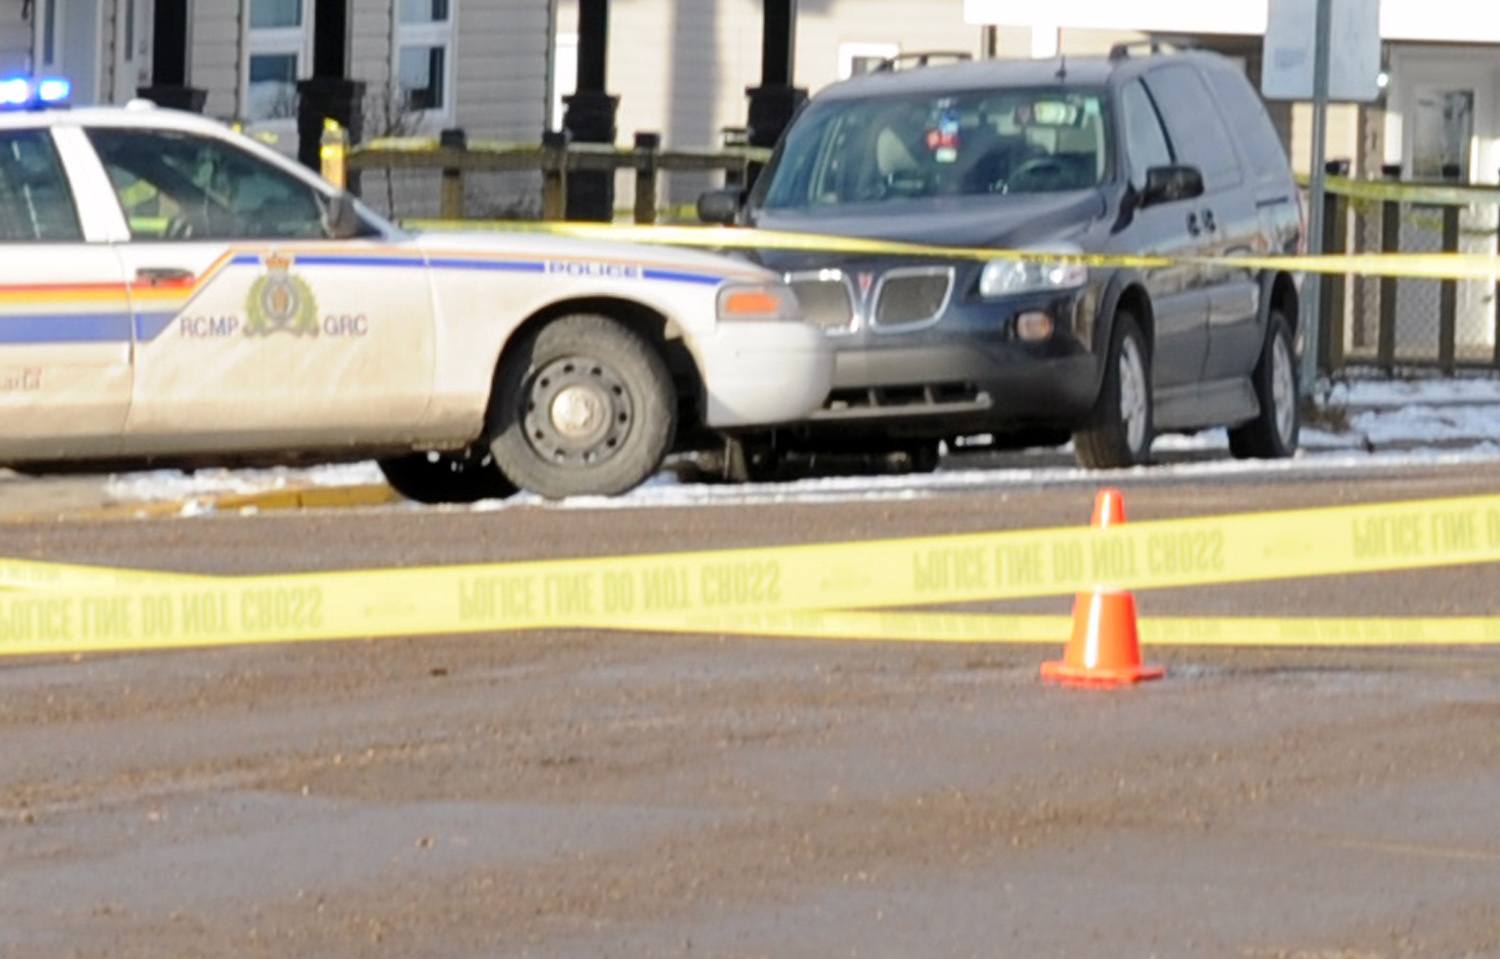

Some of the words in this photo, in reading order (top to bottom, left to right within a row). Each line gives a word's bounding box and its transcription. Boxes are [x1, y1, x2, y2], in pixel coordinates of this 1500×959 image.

[548, 263, 639, 278] POLICE
[179, 316, 240, 338] RCMP
[322, 313, 369, 337] GRC
